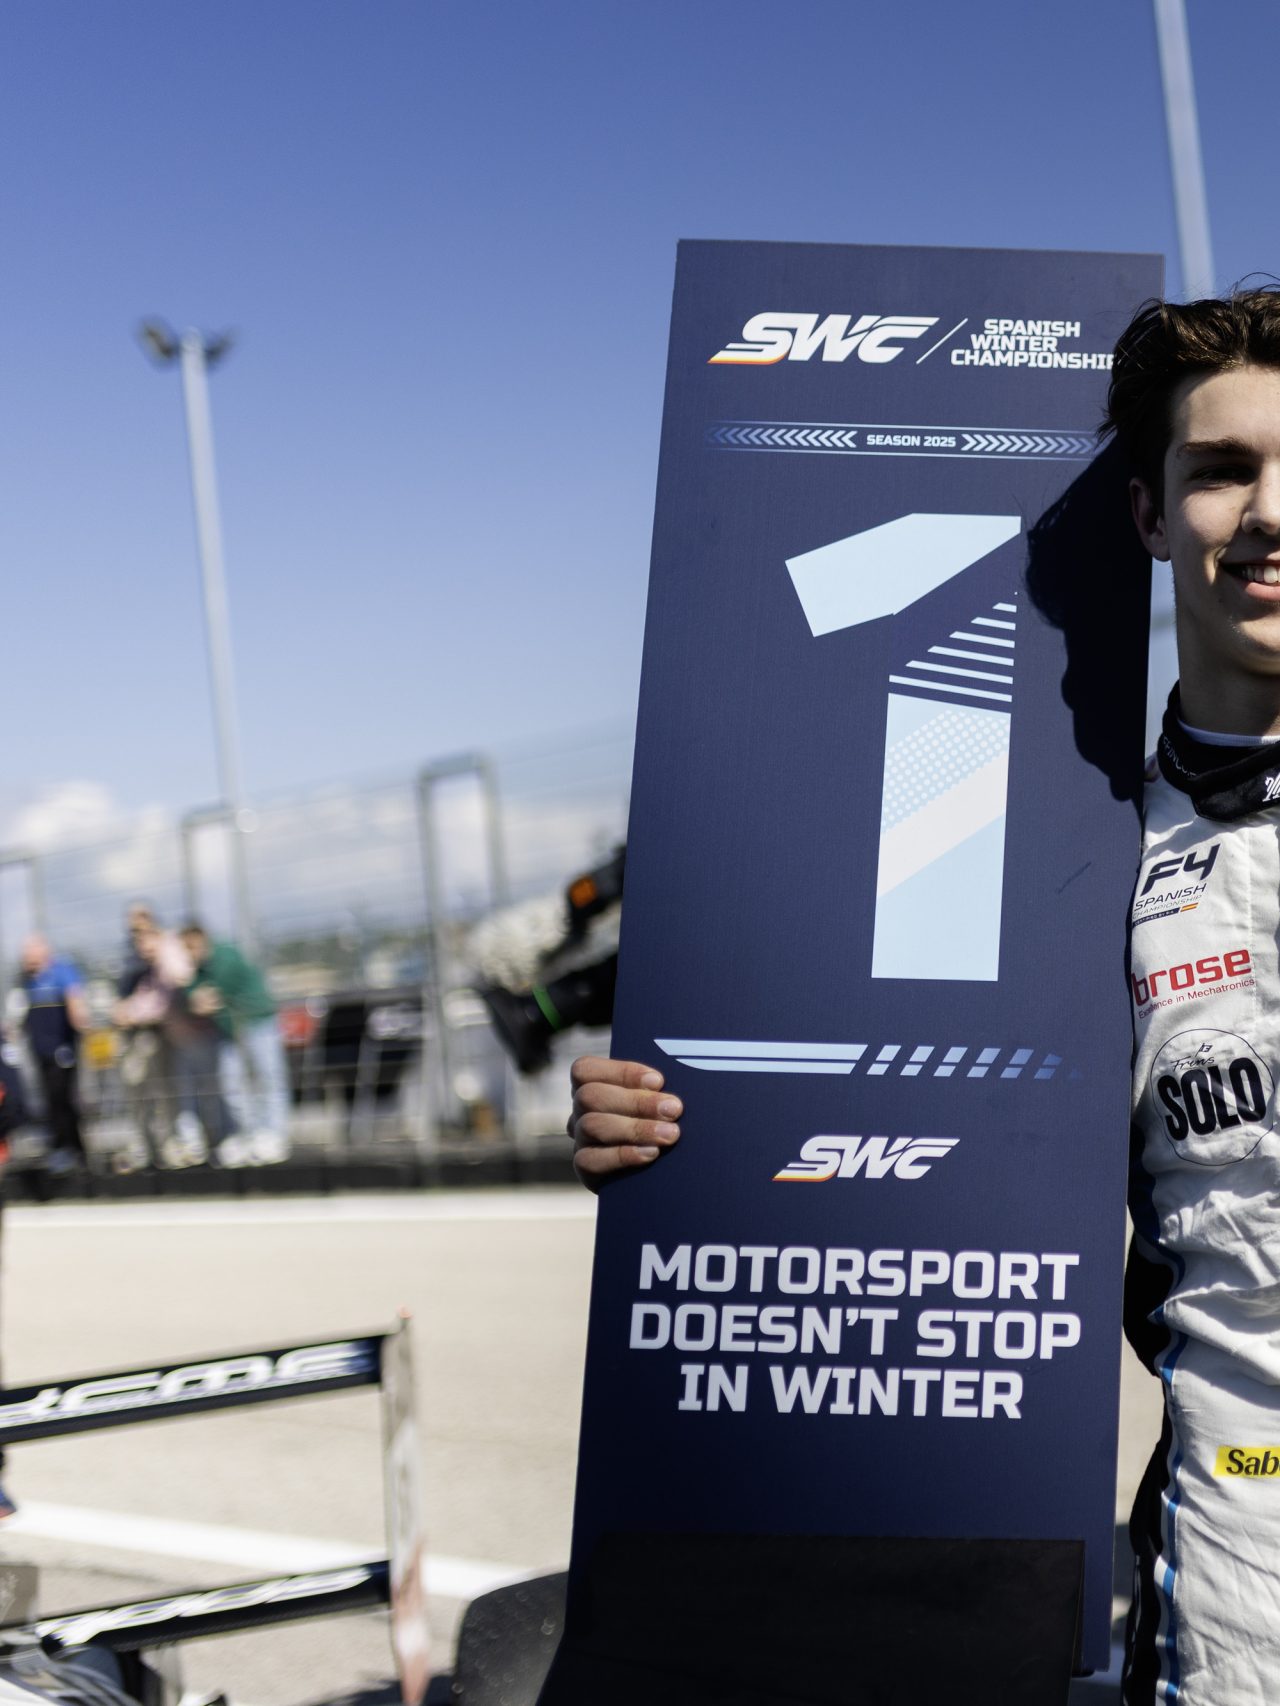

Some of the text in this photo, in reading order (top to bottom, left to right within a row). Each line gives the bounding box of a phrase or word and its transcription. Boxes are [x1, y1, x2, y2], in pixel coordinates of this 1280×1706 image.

[707, 312, 940, 366] SWC
[970, 334, 1058, 352] WINTER
[983, 319, 1081, 338] SPANISH
[866, 434, 957, 448] SEASON 2025
[1140, 843, 1221, 897] F4
[1134, 883, 1207, 912] SPANISH
[1131, 949, 1252, 1007] brose
[1175, 994, 1185, 1004] in
[1187, 979, 1255, 1001] Mechatronics
[1157, 1057, 1267, 1141] SOLO
[772, 1135, 961, 1182] SWC
[638, 1243, 1081, 1301] MOTORSPORT
[628, 1302, 1082, 1360] DOESN'T STOP
[678, 1363, 1024, 1419] IN WINTER
